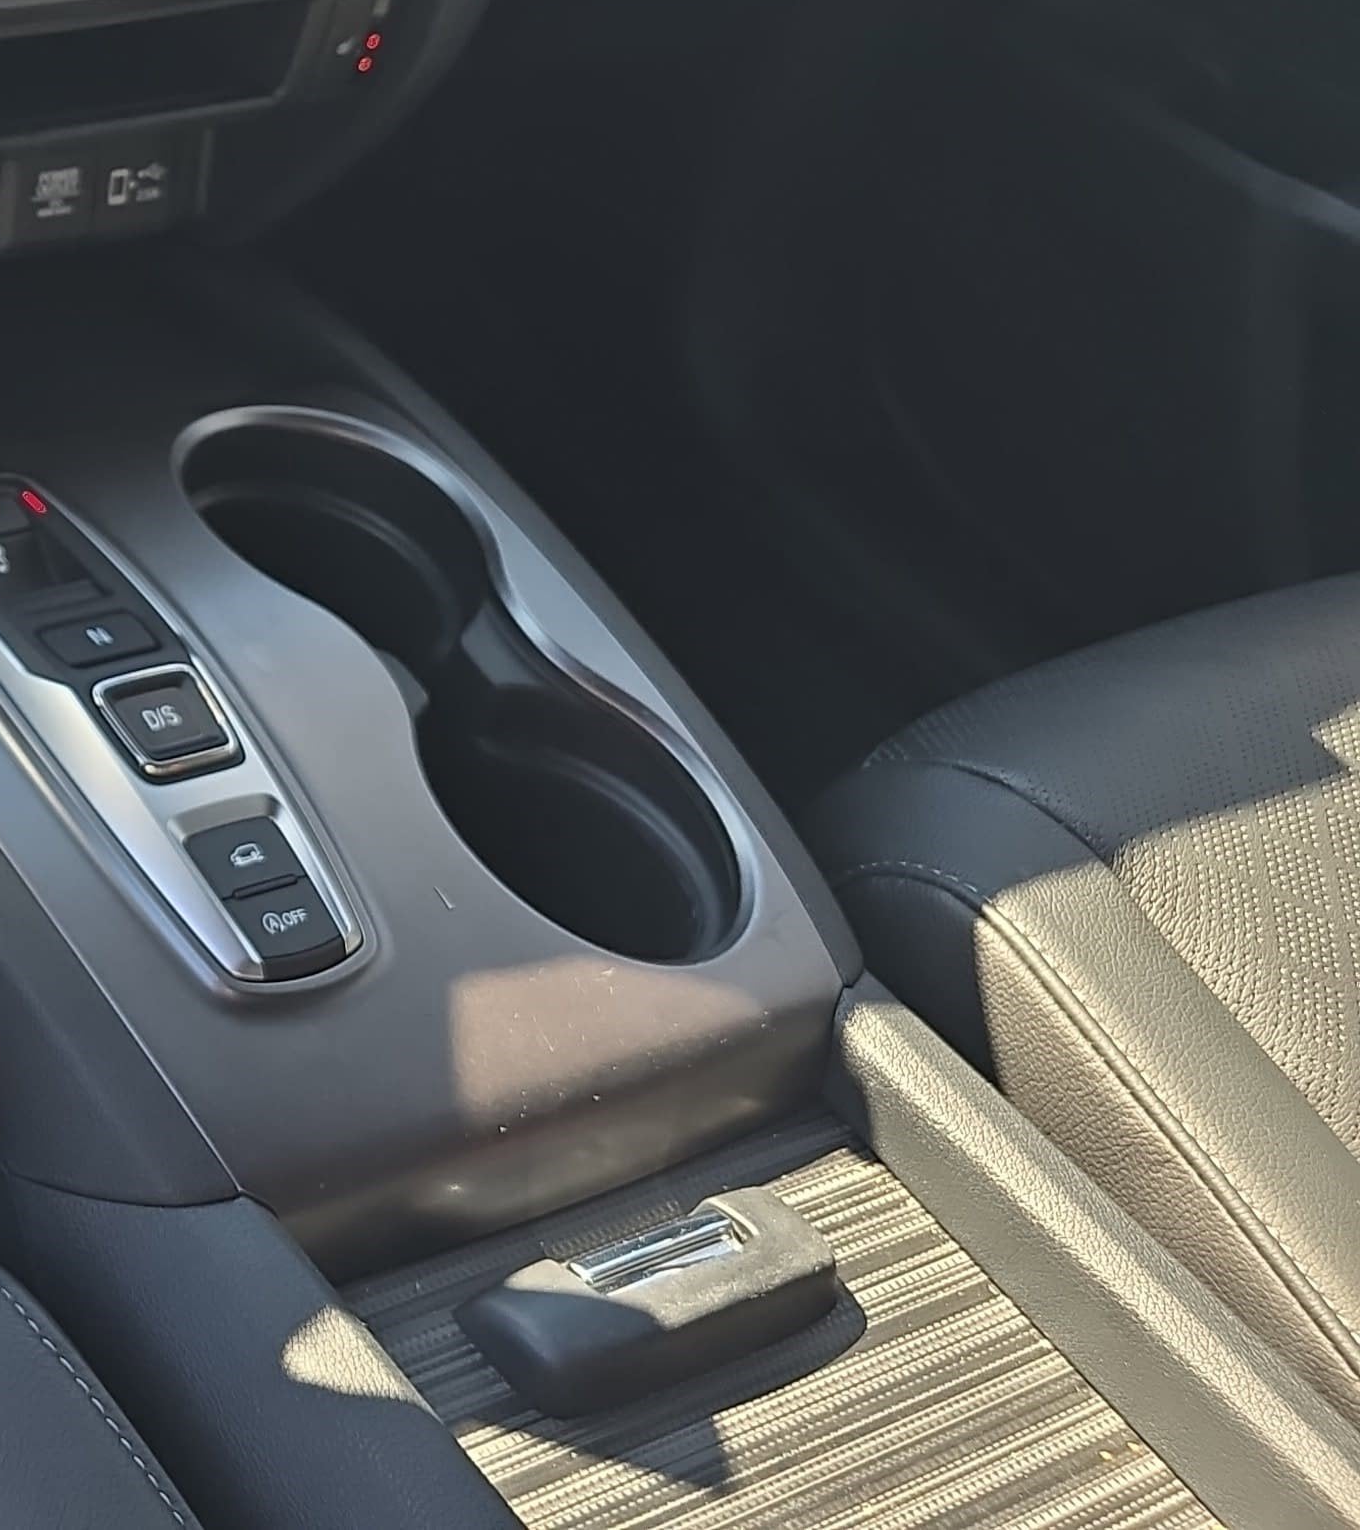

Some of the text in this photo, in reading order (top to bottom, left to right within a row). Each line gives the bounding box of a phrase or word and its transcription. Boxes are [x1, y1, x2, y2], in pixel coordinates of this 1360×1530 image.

[86, 627, 114, 647] N
[141, 704, 183, 732] D/S
[281, 907, 307, 927] OFF
